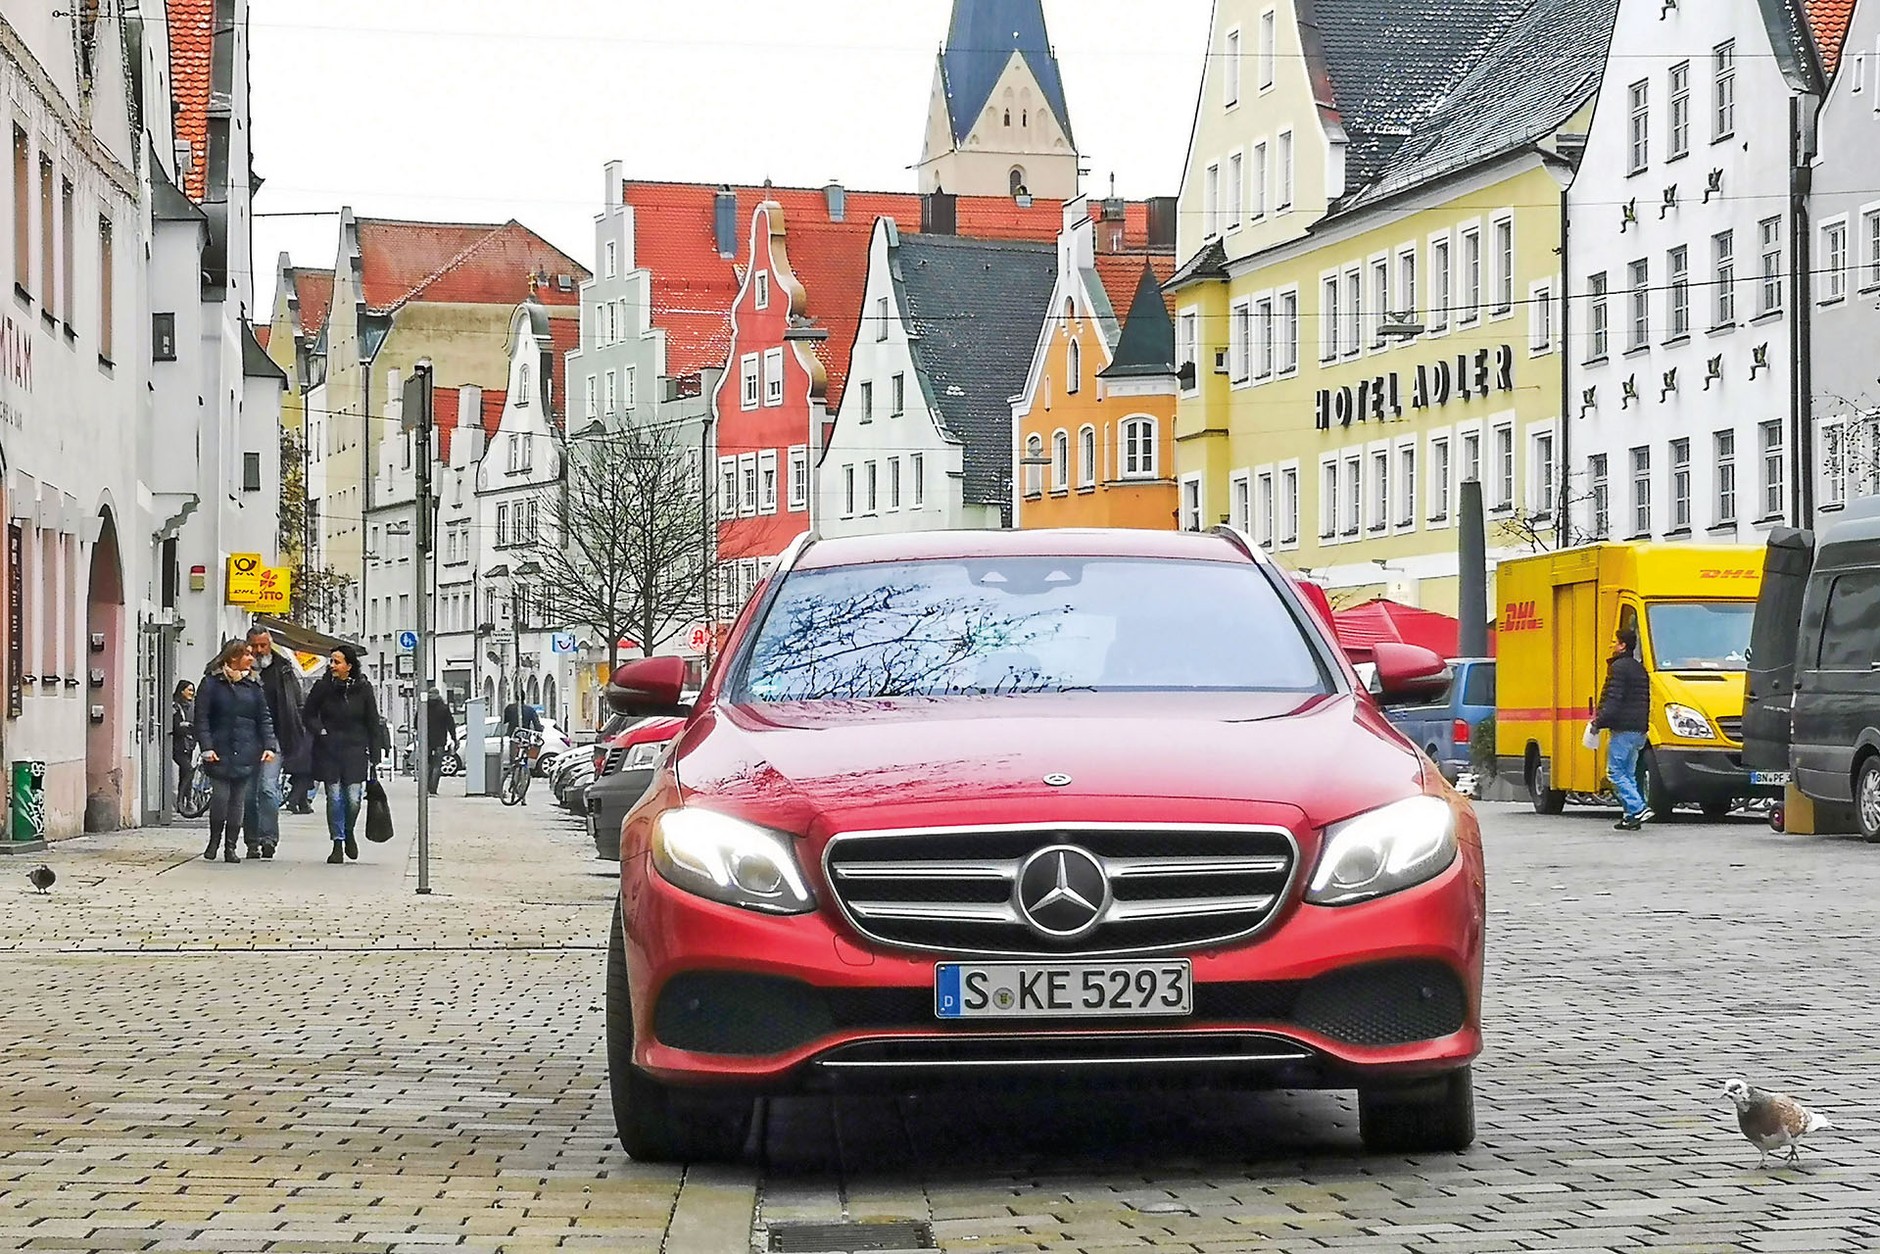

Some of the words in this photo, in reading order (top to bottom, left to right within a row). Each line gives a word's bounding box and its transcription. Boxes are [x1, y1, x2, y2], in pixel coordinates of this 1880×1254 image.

[1316, 371, 1402, 430] HOTEL
[1412, 344, 1514, 409] ADLER
[1700, 569, 1760, 579] DHL
[1503, 600, 1540, 632] DHL
[943, 995, 954, 1007] D
[964, 970, 989, 1009] S
[1018, 970, 1072, 1010] KE
[1082, 968, 1184, 1009] 5293
